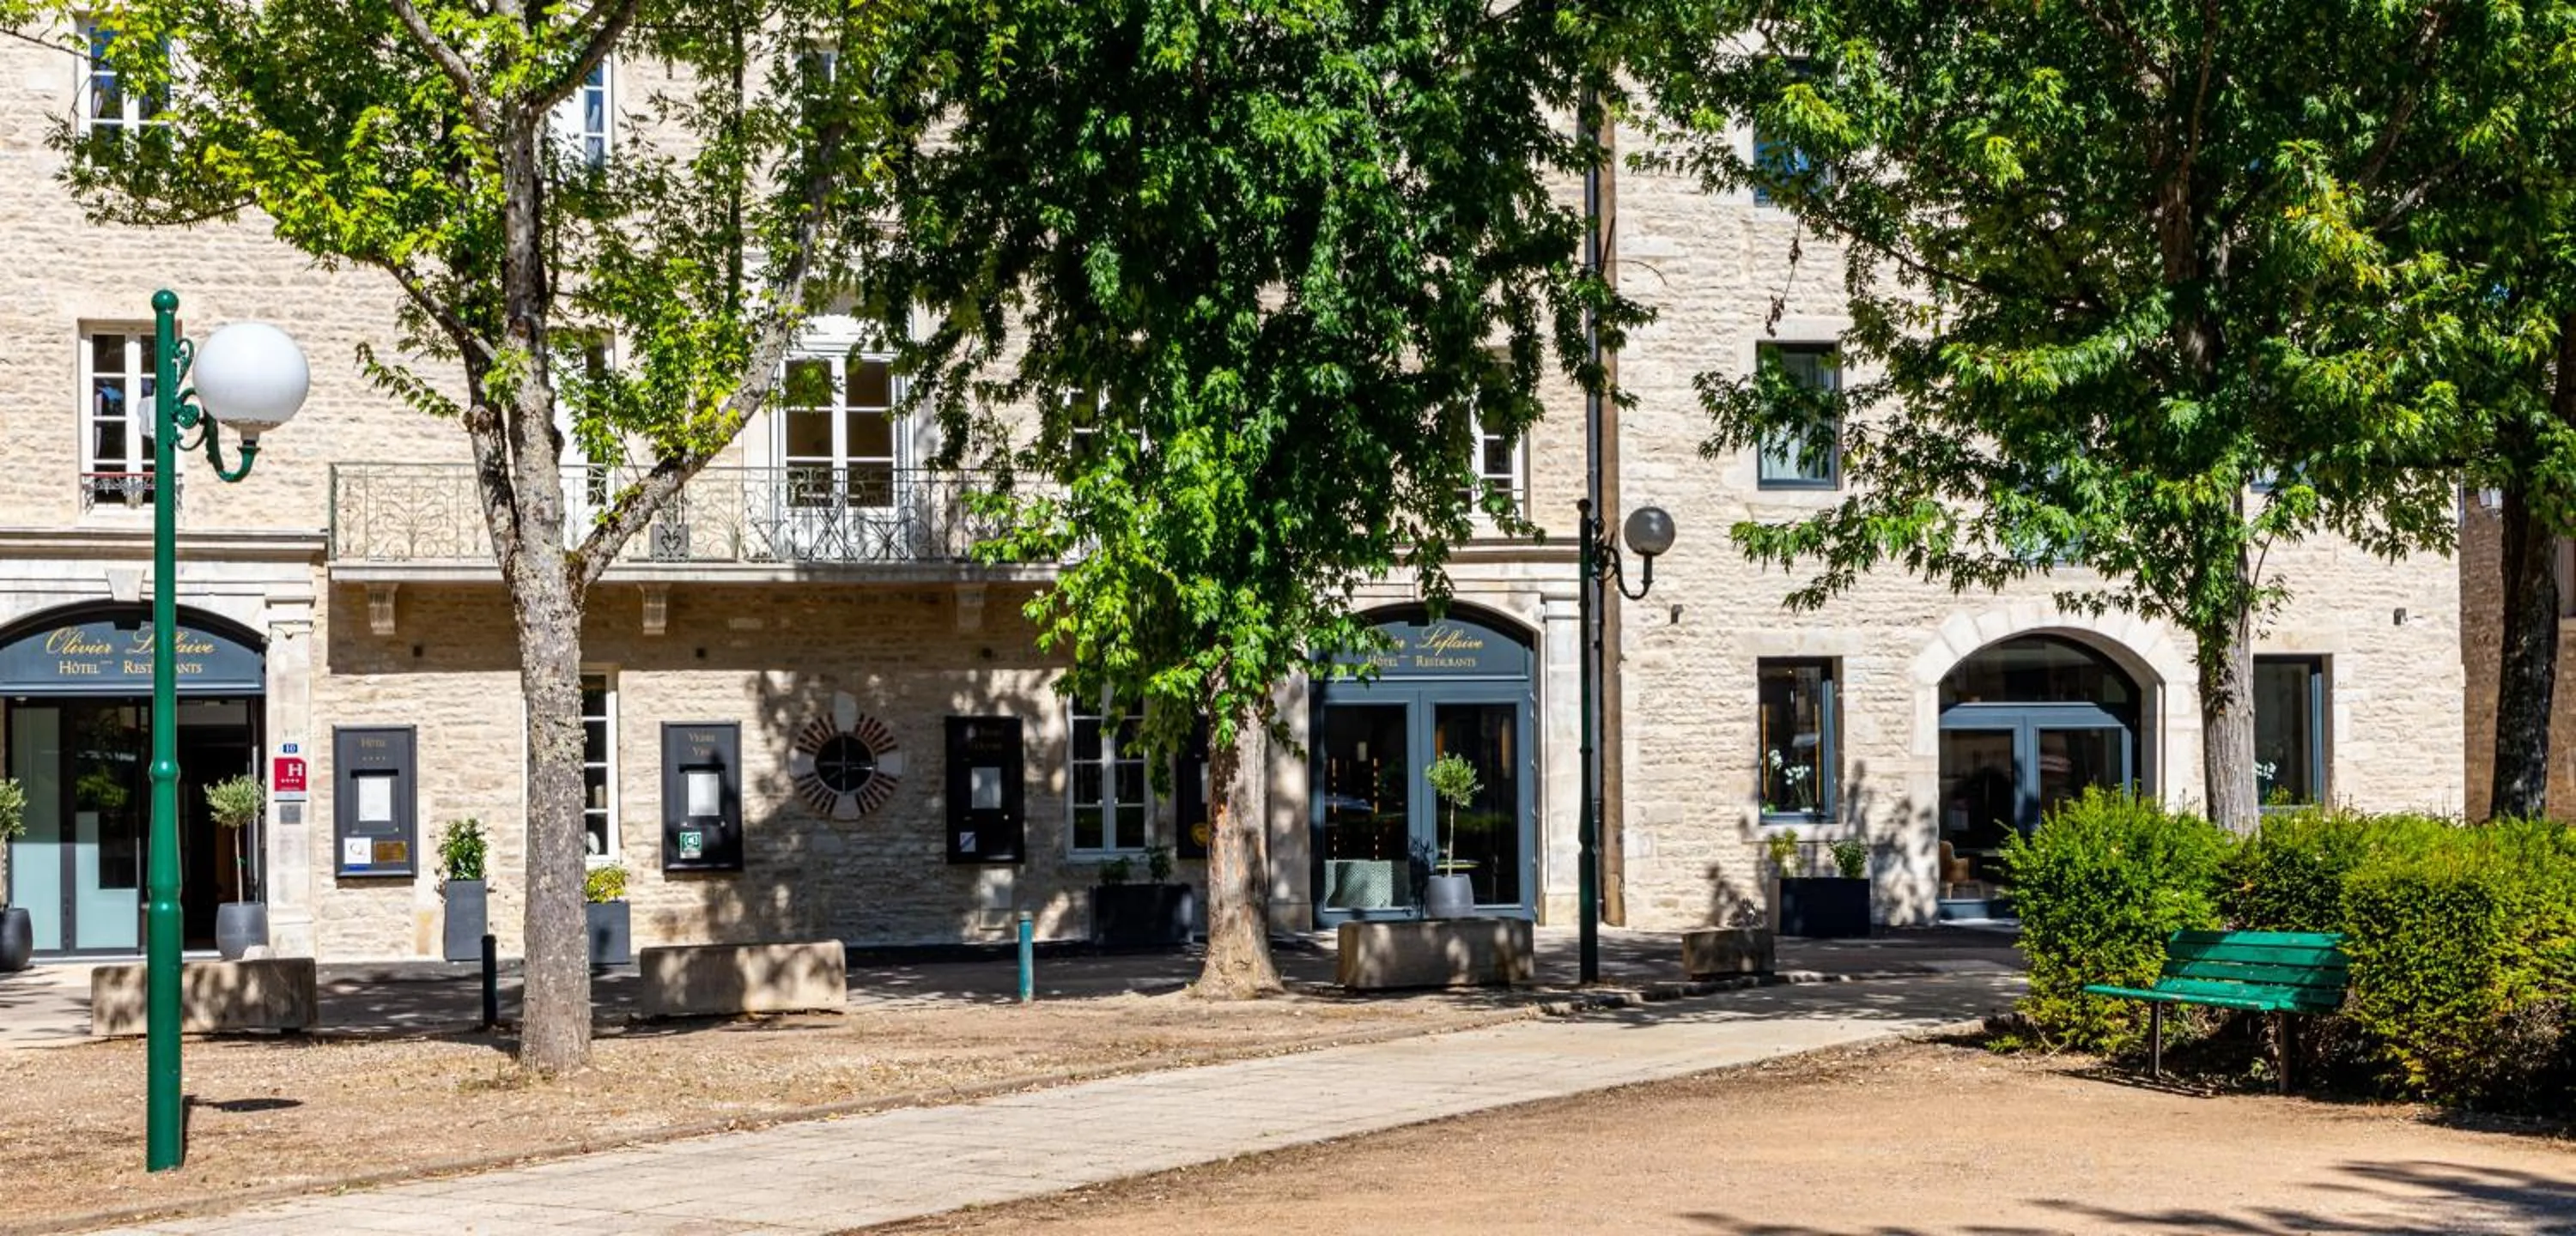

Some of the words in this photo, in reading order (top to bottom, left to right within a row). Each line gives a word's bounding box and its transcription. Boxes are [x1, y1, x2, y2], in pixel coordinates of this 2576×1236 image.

[46, 627, 112, 654] Olivier
[59, 660, 100, 674] HÔTEL
[124, 659, 203, 674] RESTNTS
[288, 763, 303, 777] H
